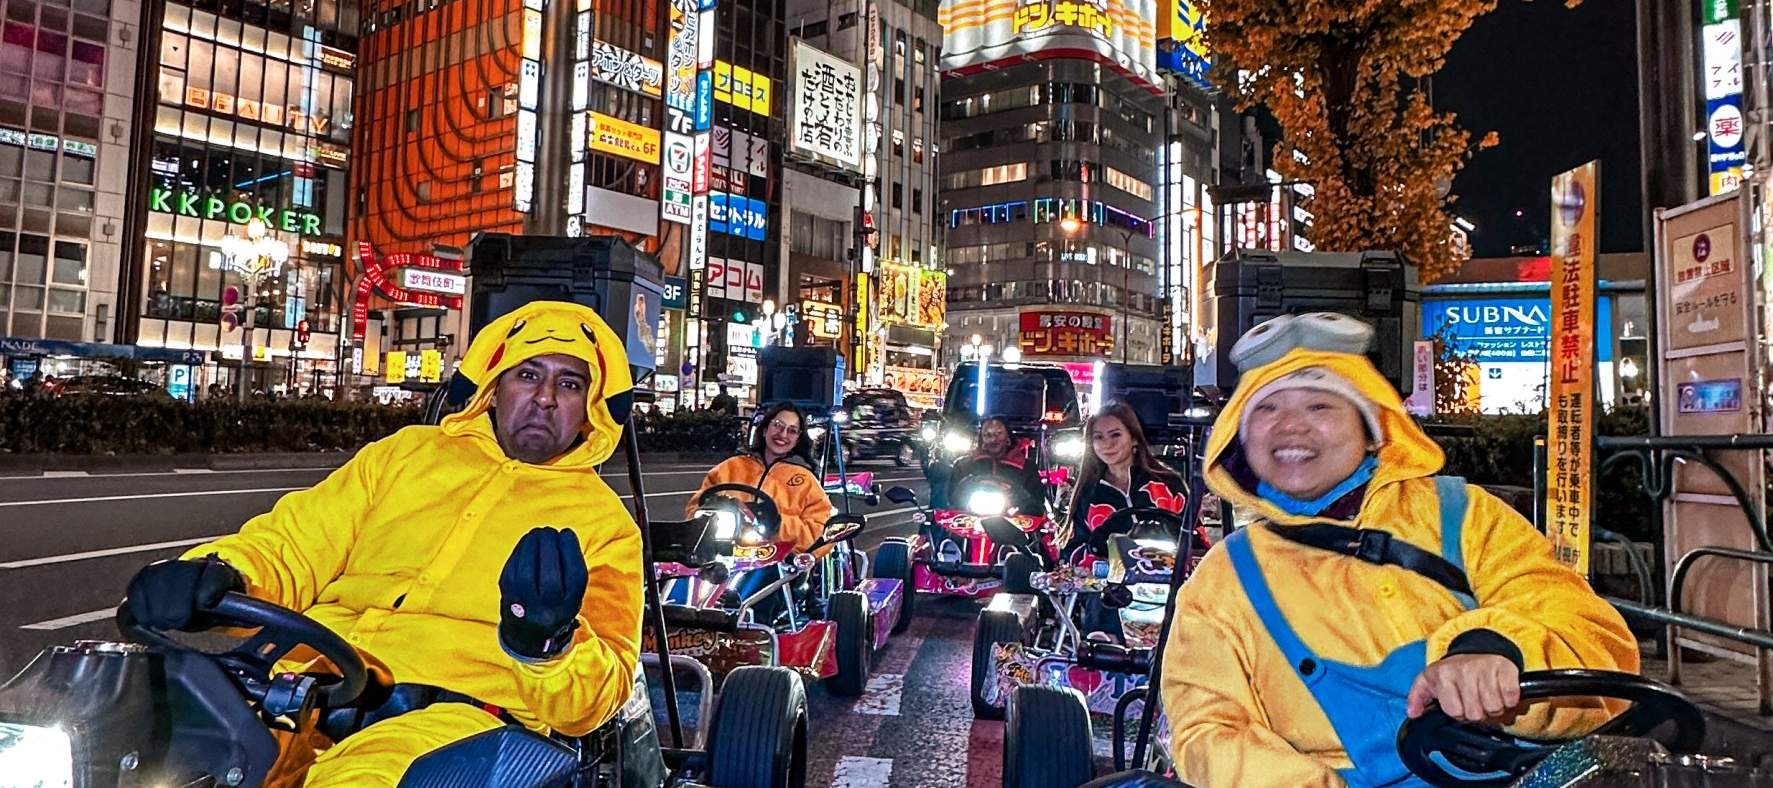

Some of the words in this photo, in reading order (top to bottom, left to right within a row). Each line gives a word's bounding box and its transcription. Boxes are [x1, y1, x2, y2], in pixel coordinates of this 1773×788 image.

[718, 73, 766, 103] プロミス
[186, 86, 328, 134] BEAUTY
[668, 108, 692, 134] 7F
[1714, 117, 1740, 137] 薬
[643, 142, 657, 156] 6F
[151, 188, 322, 236] KKPOKER
[665, 203, 689, 217] ATM
[710, 200, 766, 229] セントラル
[708, 263, 761, 291] アコム
[663, 284, 681, 300] 3F
[1445, 304, 1549, 326] SUBNA
[174, 368, 184, 382] P
